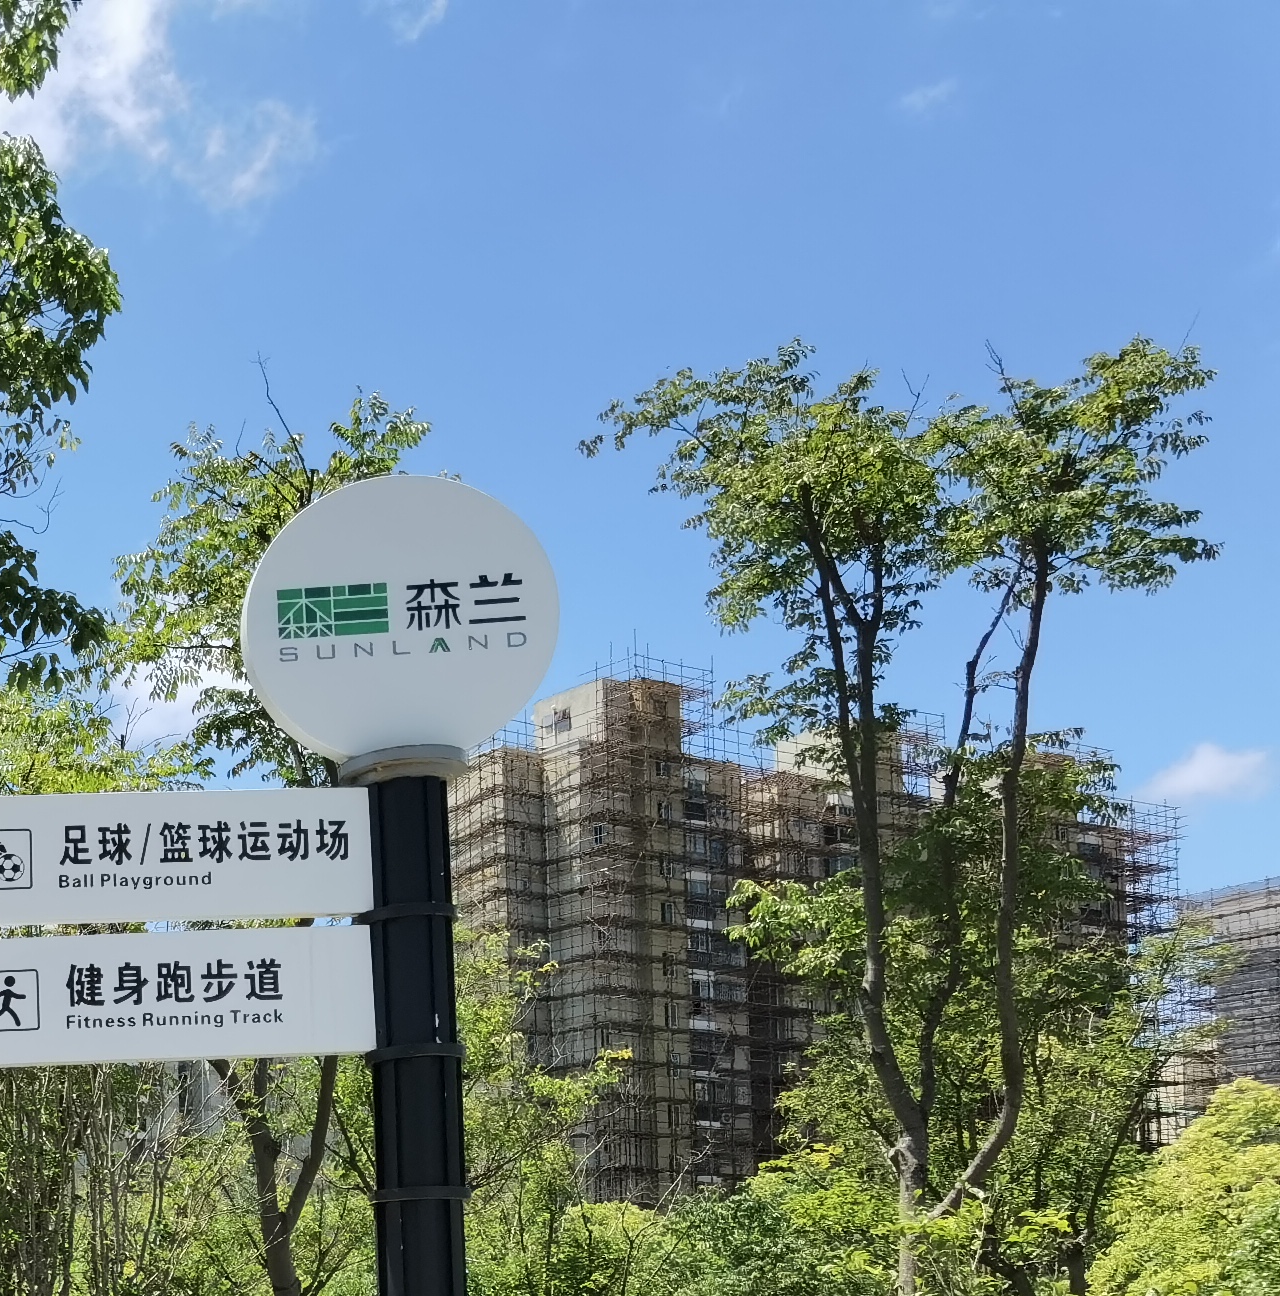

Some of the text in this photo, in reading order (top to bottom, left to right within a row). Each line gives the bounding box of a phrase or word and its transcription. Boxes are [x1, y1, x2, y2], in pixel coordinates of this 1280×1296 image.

[405, 572, 527, 632] 森兰
[279, 632, 528, 663] SUNLAND
[58, 818, 350, 866] 足球/篮球运动场
[58, 871, 212, 891] Ball Playground
[65, 957, 284, 1007] 健身跑步道
[66, 1008, 284, 1030] Fitness Running Track
